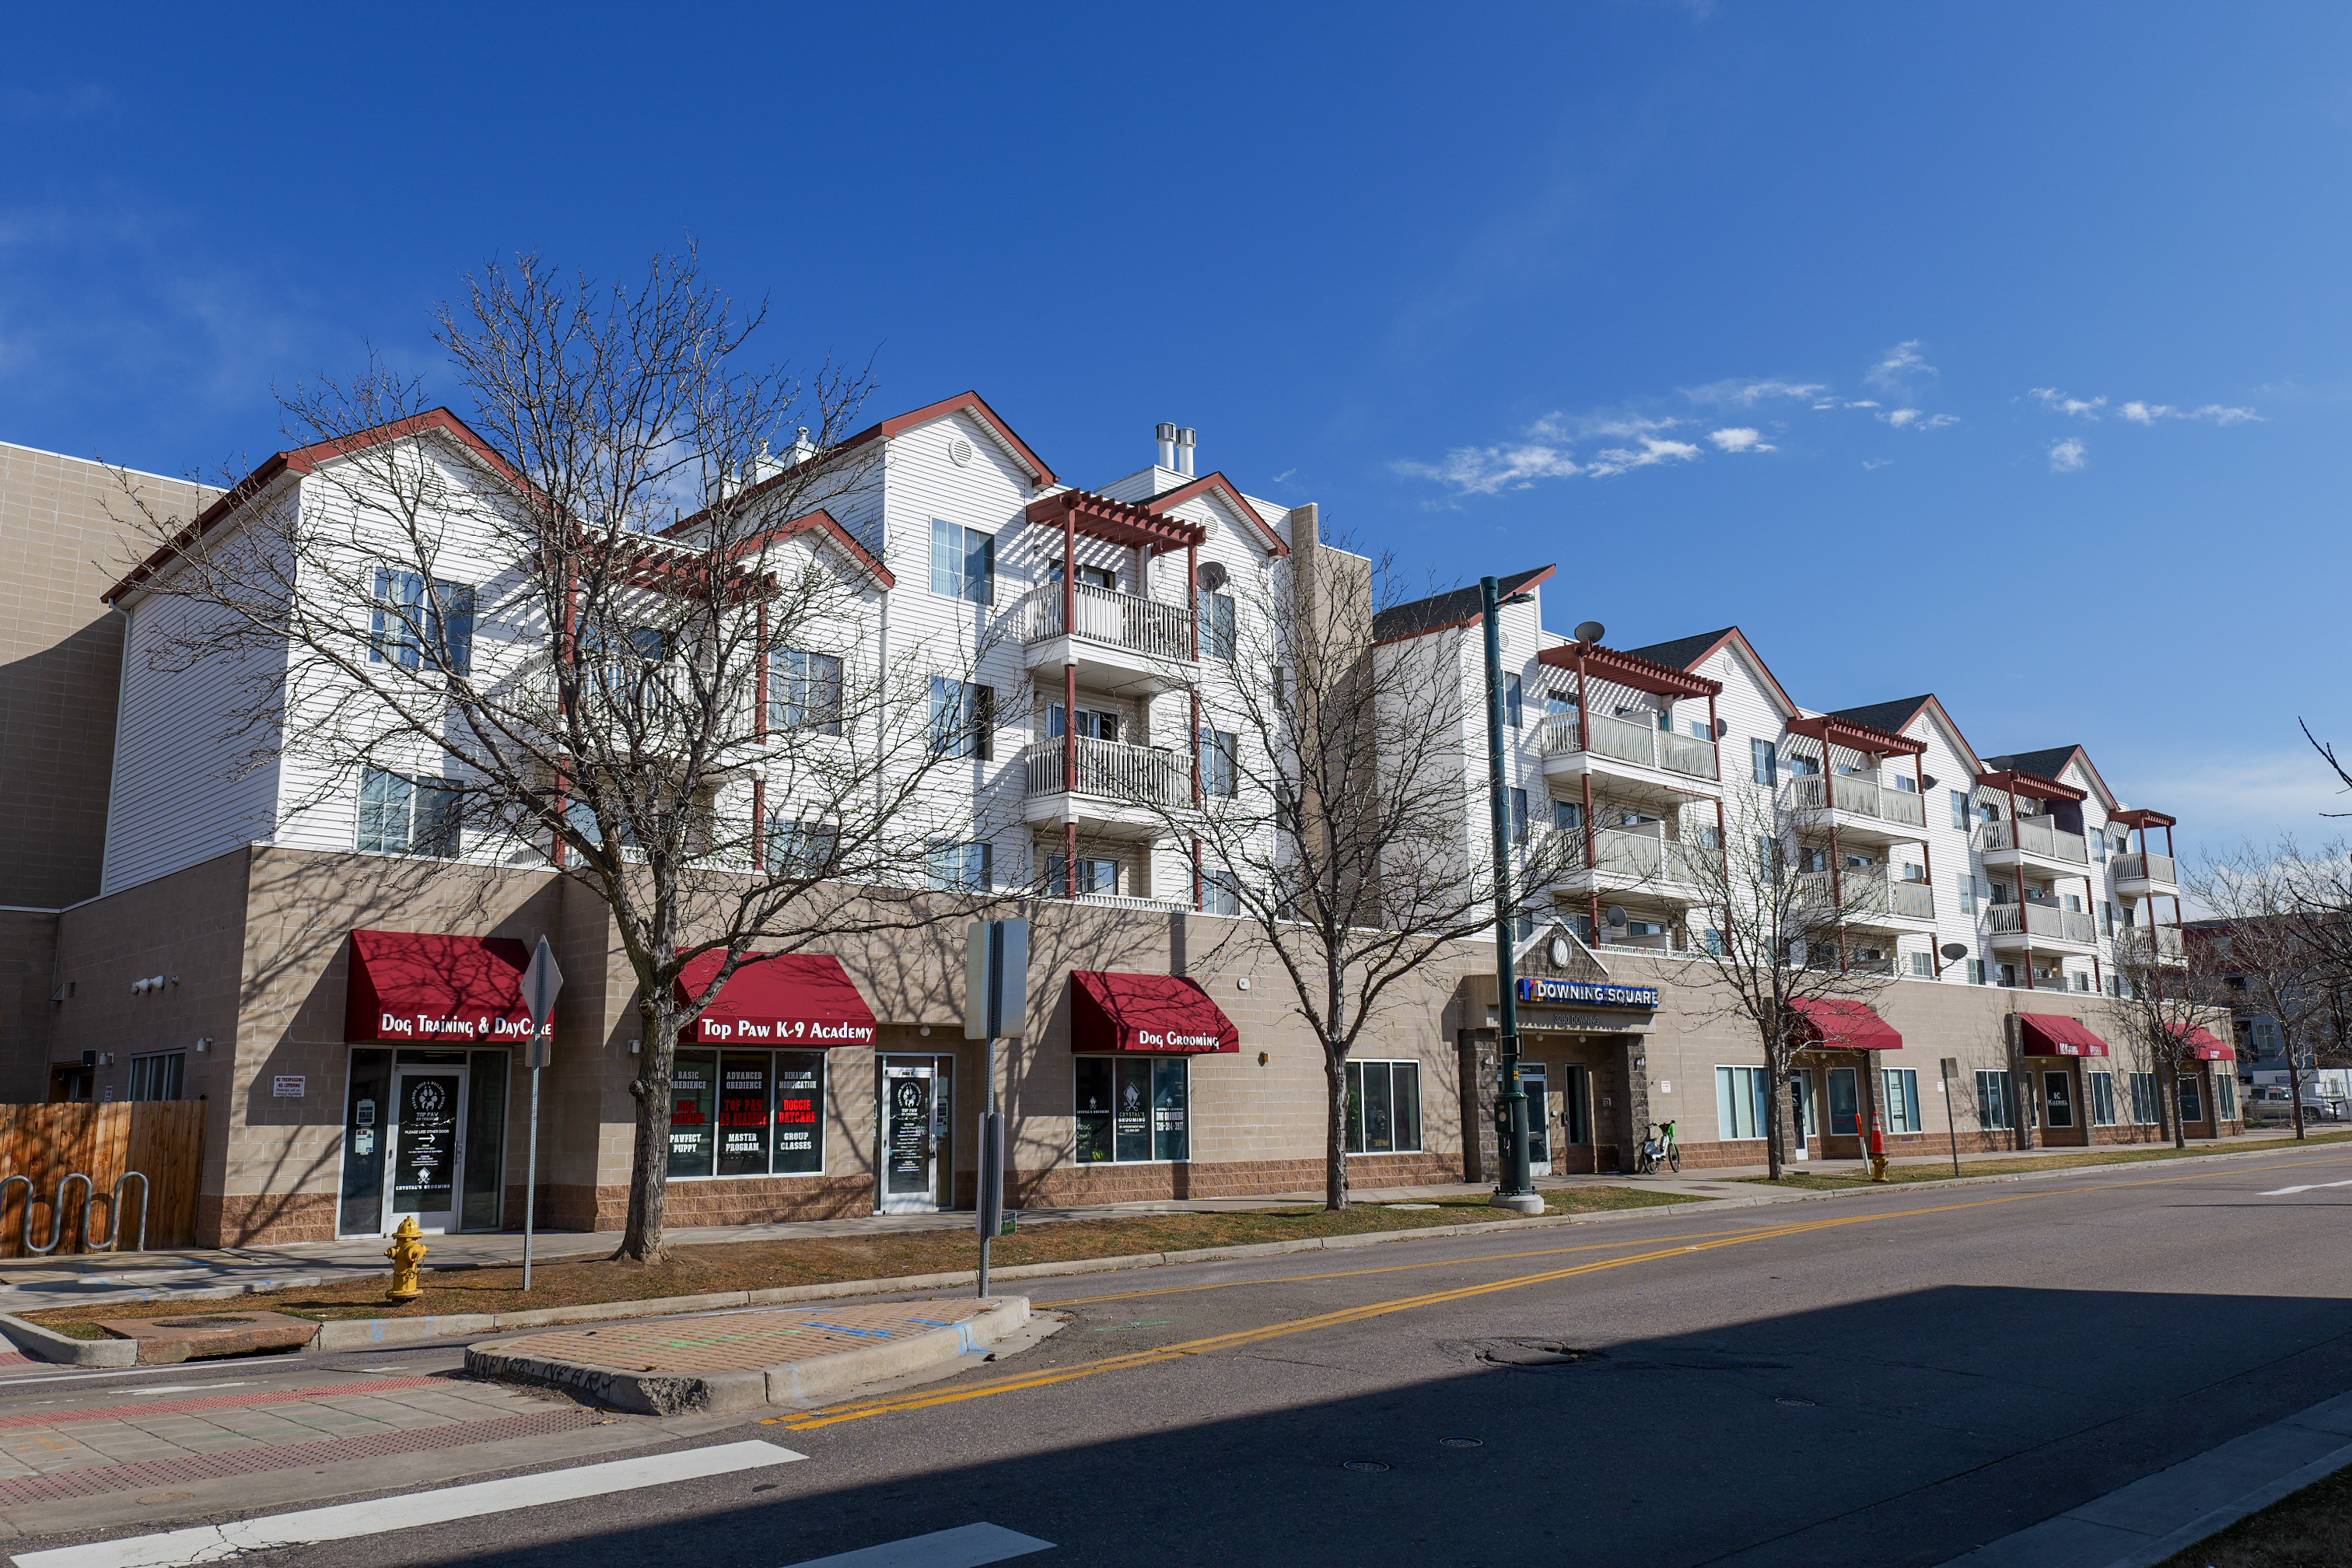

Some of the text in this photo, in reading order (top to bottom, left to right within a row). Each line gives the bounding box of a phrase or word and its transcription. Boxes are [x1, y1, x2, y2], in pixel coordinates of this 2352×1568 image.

[1537, 983, 1659, 1005] DOWNING SQUARE
[1554, 1014, 1599, 1025] 3280 DOWNING
[478, 1017, 489, 1034] &
[702, 1018, 873, 1043] Top Paw K-9 Academy
[1139, 1030, 1220, 1050] Dog Grooming
[677, 1071, 699, 1080] BASIC
[726, 1071, 762, 1080] ADVANCED
[784, 1071, 812, 1080] BEHAVIOR
[726, 1080, 762, 1089] OBEDIENCE
[779, 1080, 817, 1089] MODIFICATION
[677, 1101, 696, 1112] DOG
[724, 1099, 765, 1111] TOP PAW
[783, 1099, 811, 1111] DOGGIE
[719, 1111, 768, 1126] K9 ACADEMY
[779, 1111, 816, 1124] DAYCARE
[670, 1133, 702, 1143] PAWFECT
[728, 1133, 757, 1143] MASTER
[784, 1132, 809, 1141] GROUP
[673, 1143, 698, 1153] PUPPY
[725, 1142, 759, 1152] PROGRAM
[780, 1141, 812, 1150] CLASSES
